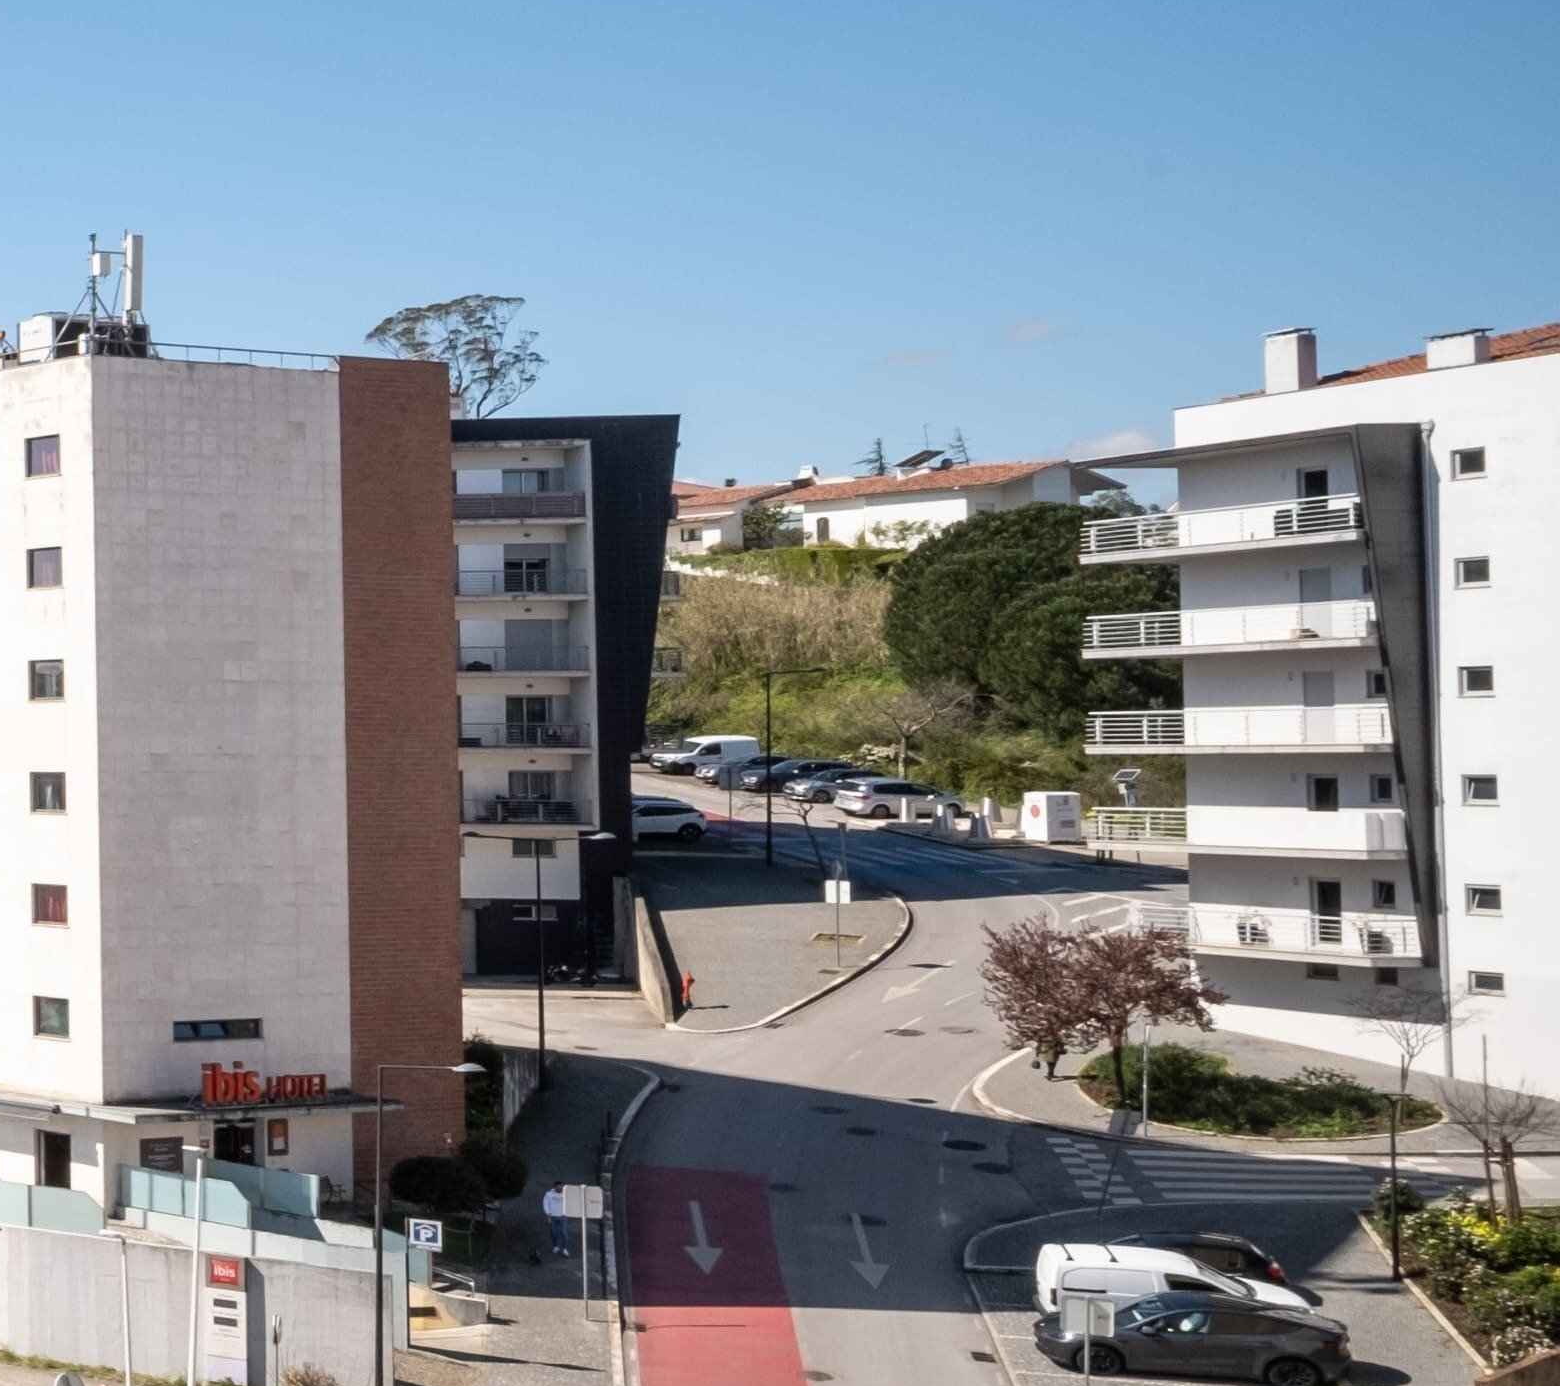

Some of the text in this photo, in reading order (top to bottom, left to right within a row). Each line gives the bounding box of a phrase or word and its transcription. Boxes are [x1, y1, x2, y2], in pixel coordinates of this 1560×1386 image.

[202, 1061, 329, 1105] ibis HOTEL
[213, 1264, 236, 1280] ibis
